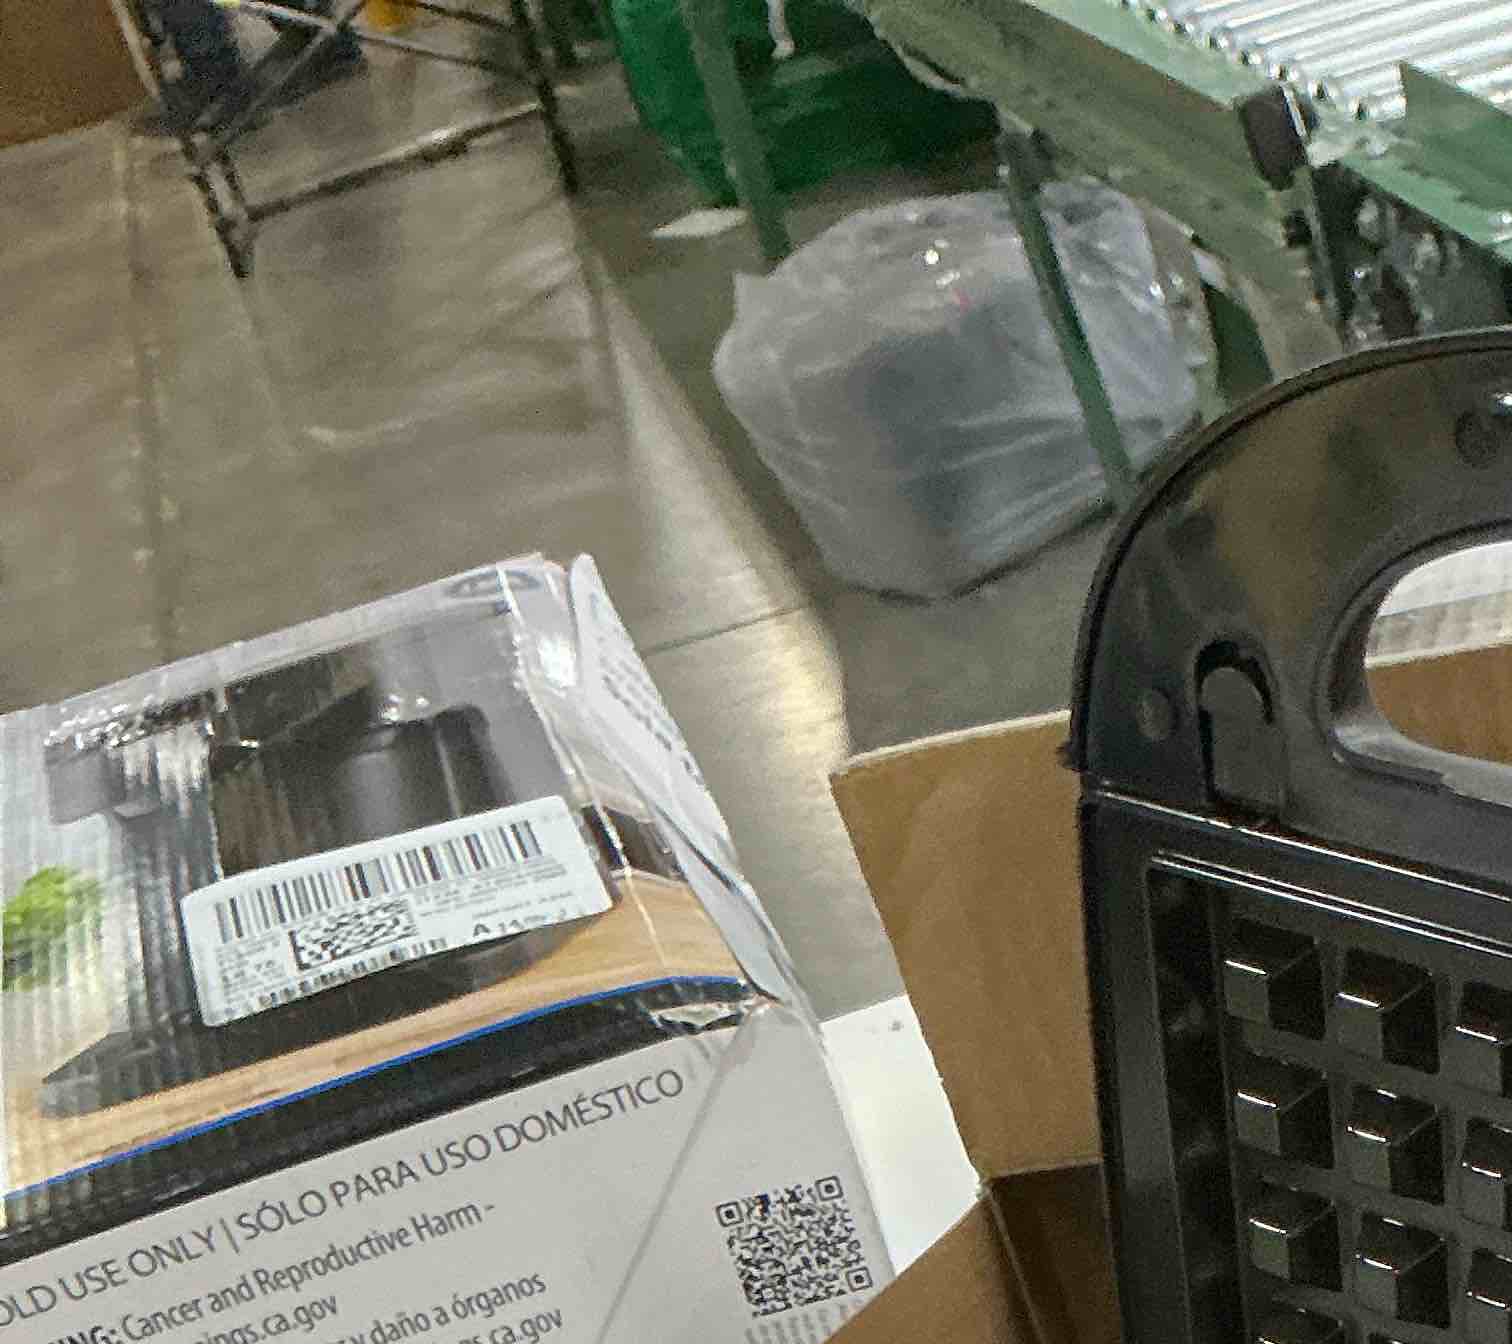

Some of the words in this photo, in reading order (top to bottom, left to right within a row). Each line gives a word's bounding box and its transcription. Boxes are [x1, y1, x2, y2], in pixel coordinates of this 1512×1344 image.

[59, 1259, 128, 1302] USE
[127, 1226, 217, 1278] ONLY
[236, 1189, 328, 1241] SÓLO
[328, 1159, 421, 1208] PARA
[420, 1133, 492, 1177] USO
[493, 1068, 684, 1153] DOMÉSTICO
[120, 1298, 206, 1342] Cancer
[206, 1273, 257, 1314] and
[252, 1226, 413, 1297] Reproductive
[411, 1202, 484, 1243] Harm
[431, 1305, 451, 1327] a
[450, 1272, 548, 1321] órganos
